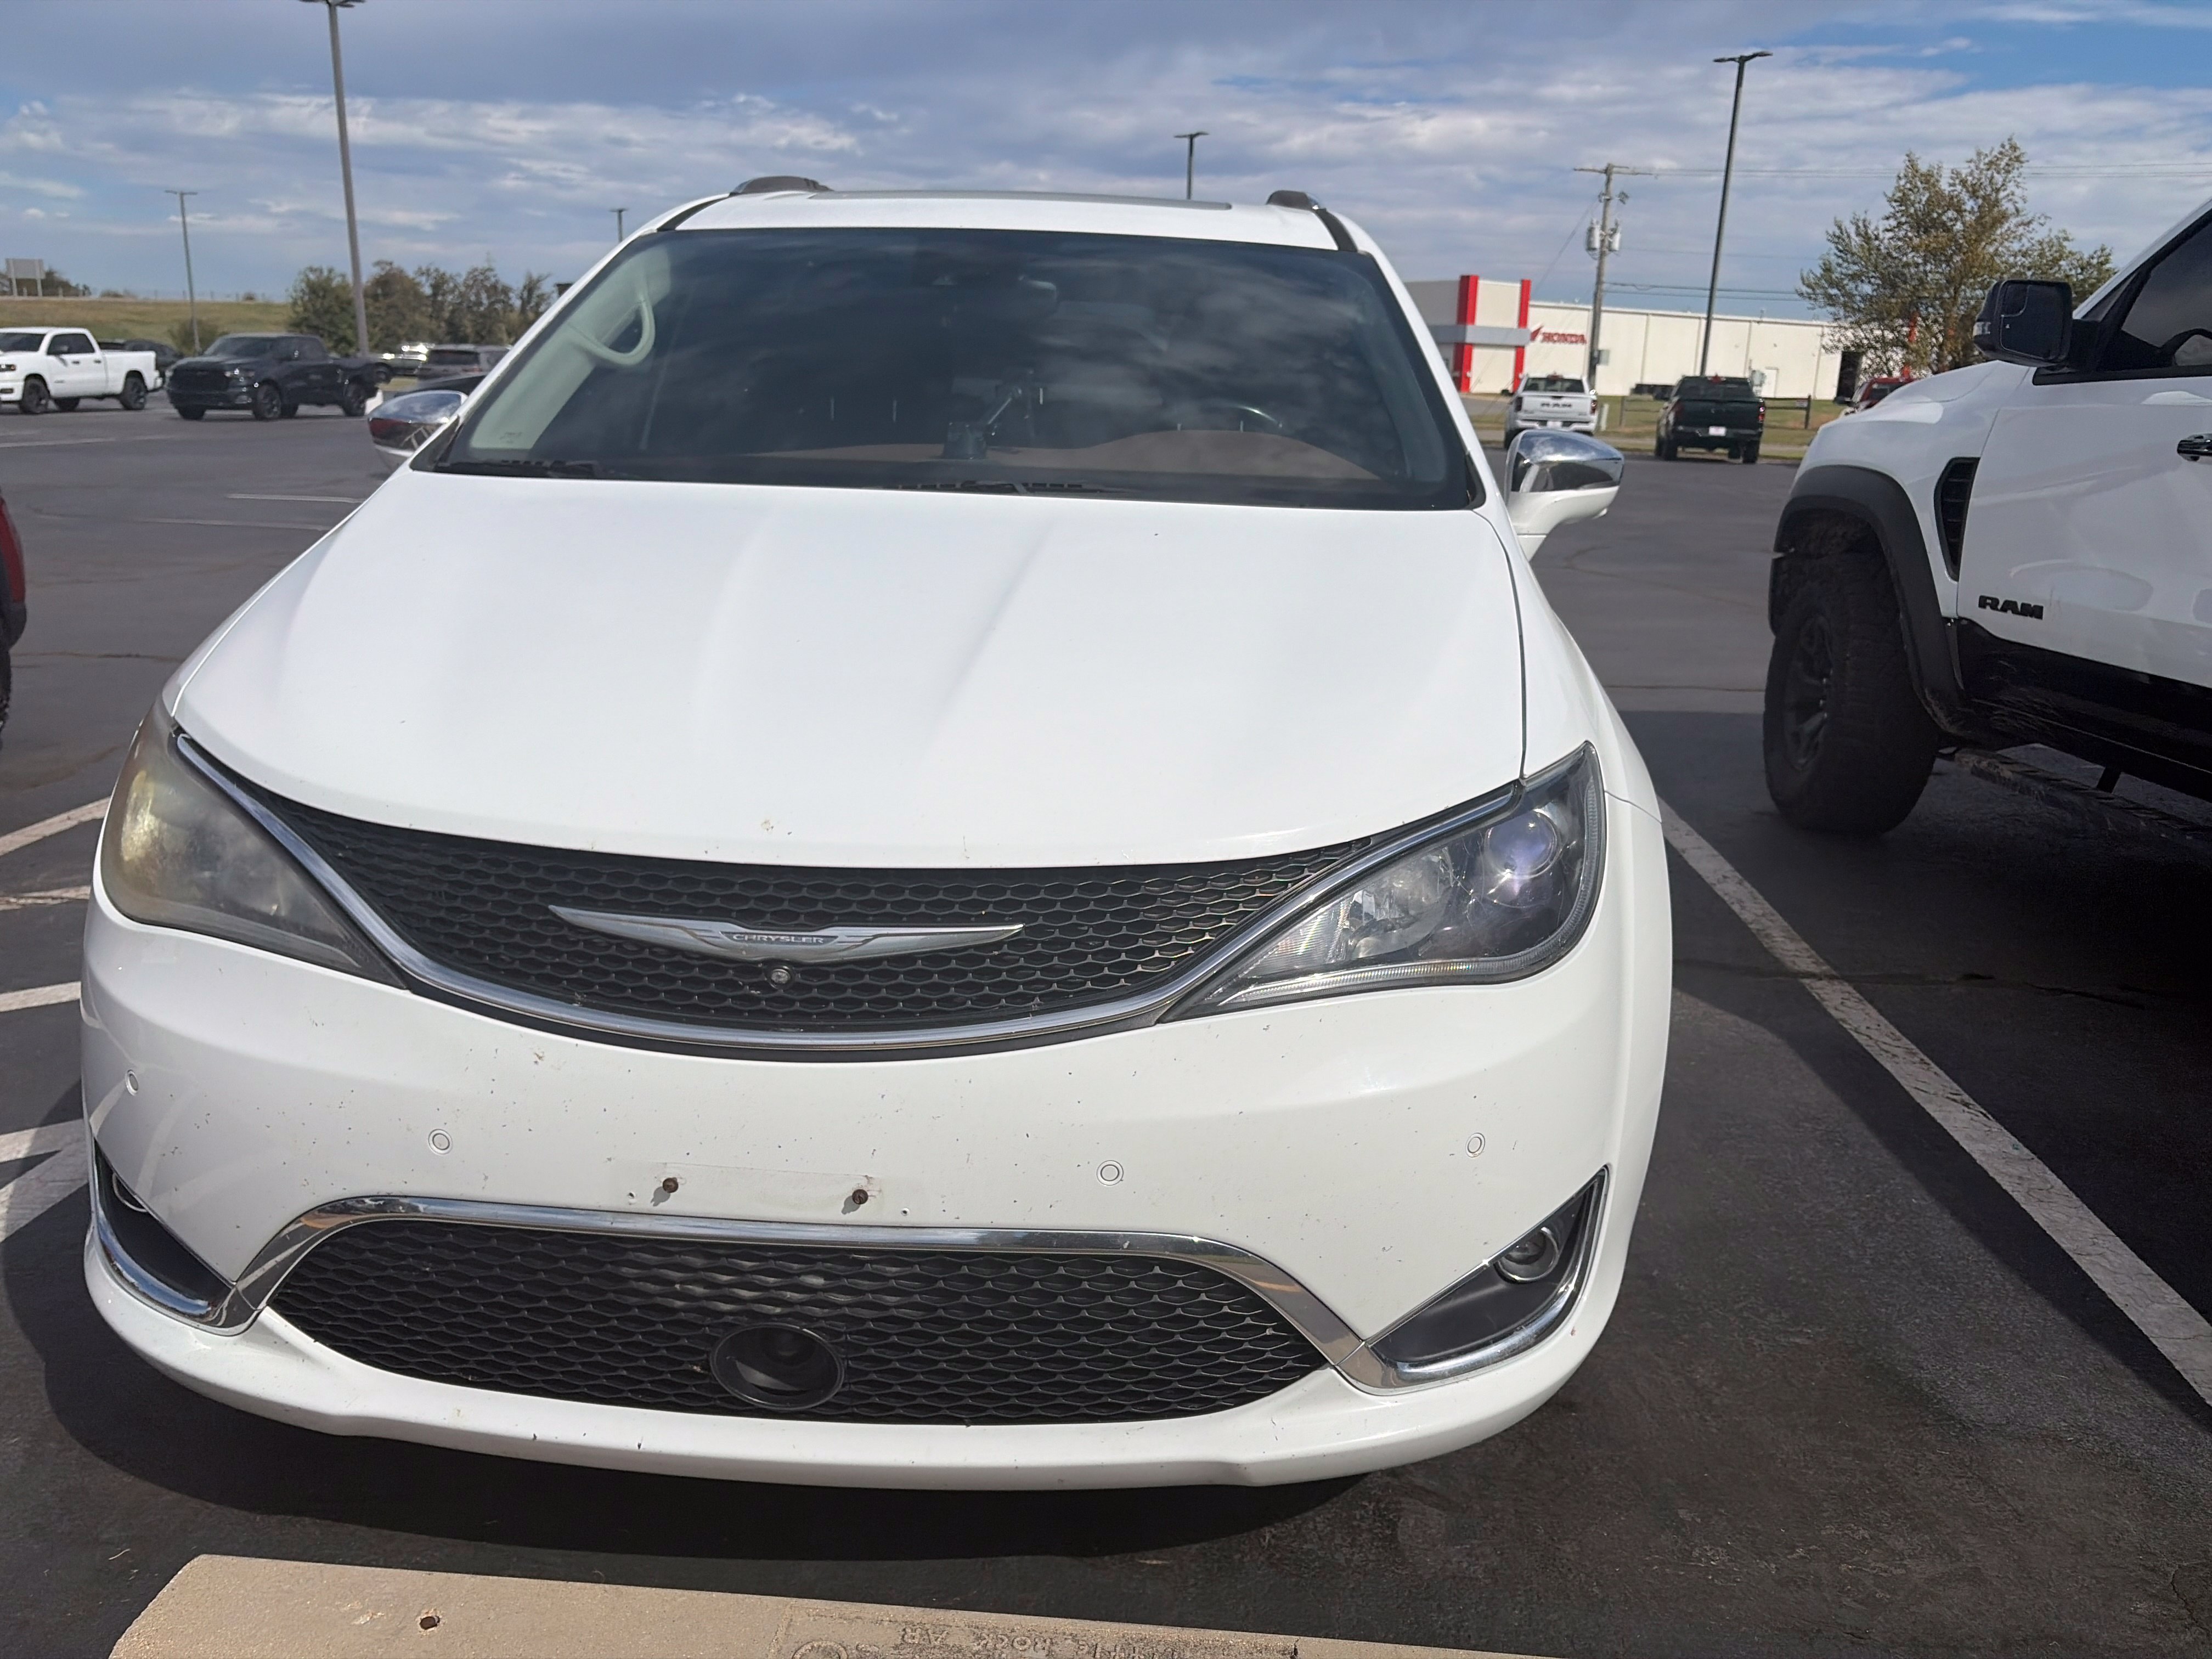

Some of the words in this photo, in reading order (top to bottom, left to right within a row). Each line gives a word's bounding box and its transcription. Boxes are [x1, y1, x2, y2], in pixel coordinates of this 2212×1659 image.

[1542, 332, 1587, 344] HONDA
[1978, 595, 2044, 620] RAM
[733, 934, 823, 944] CHRYSLER
